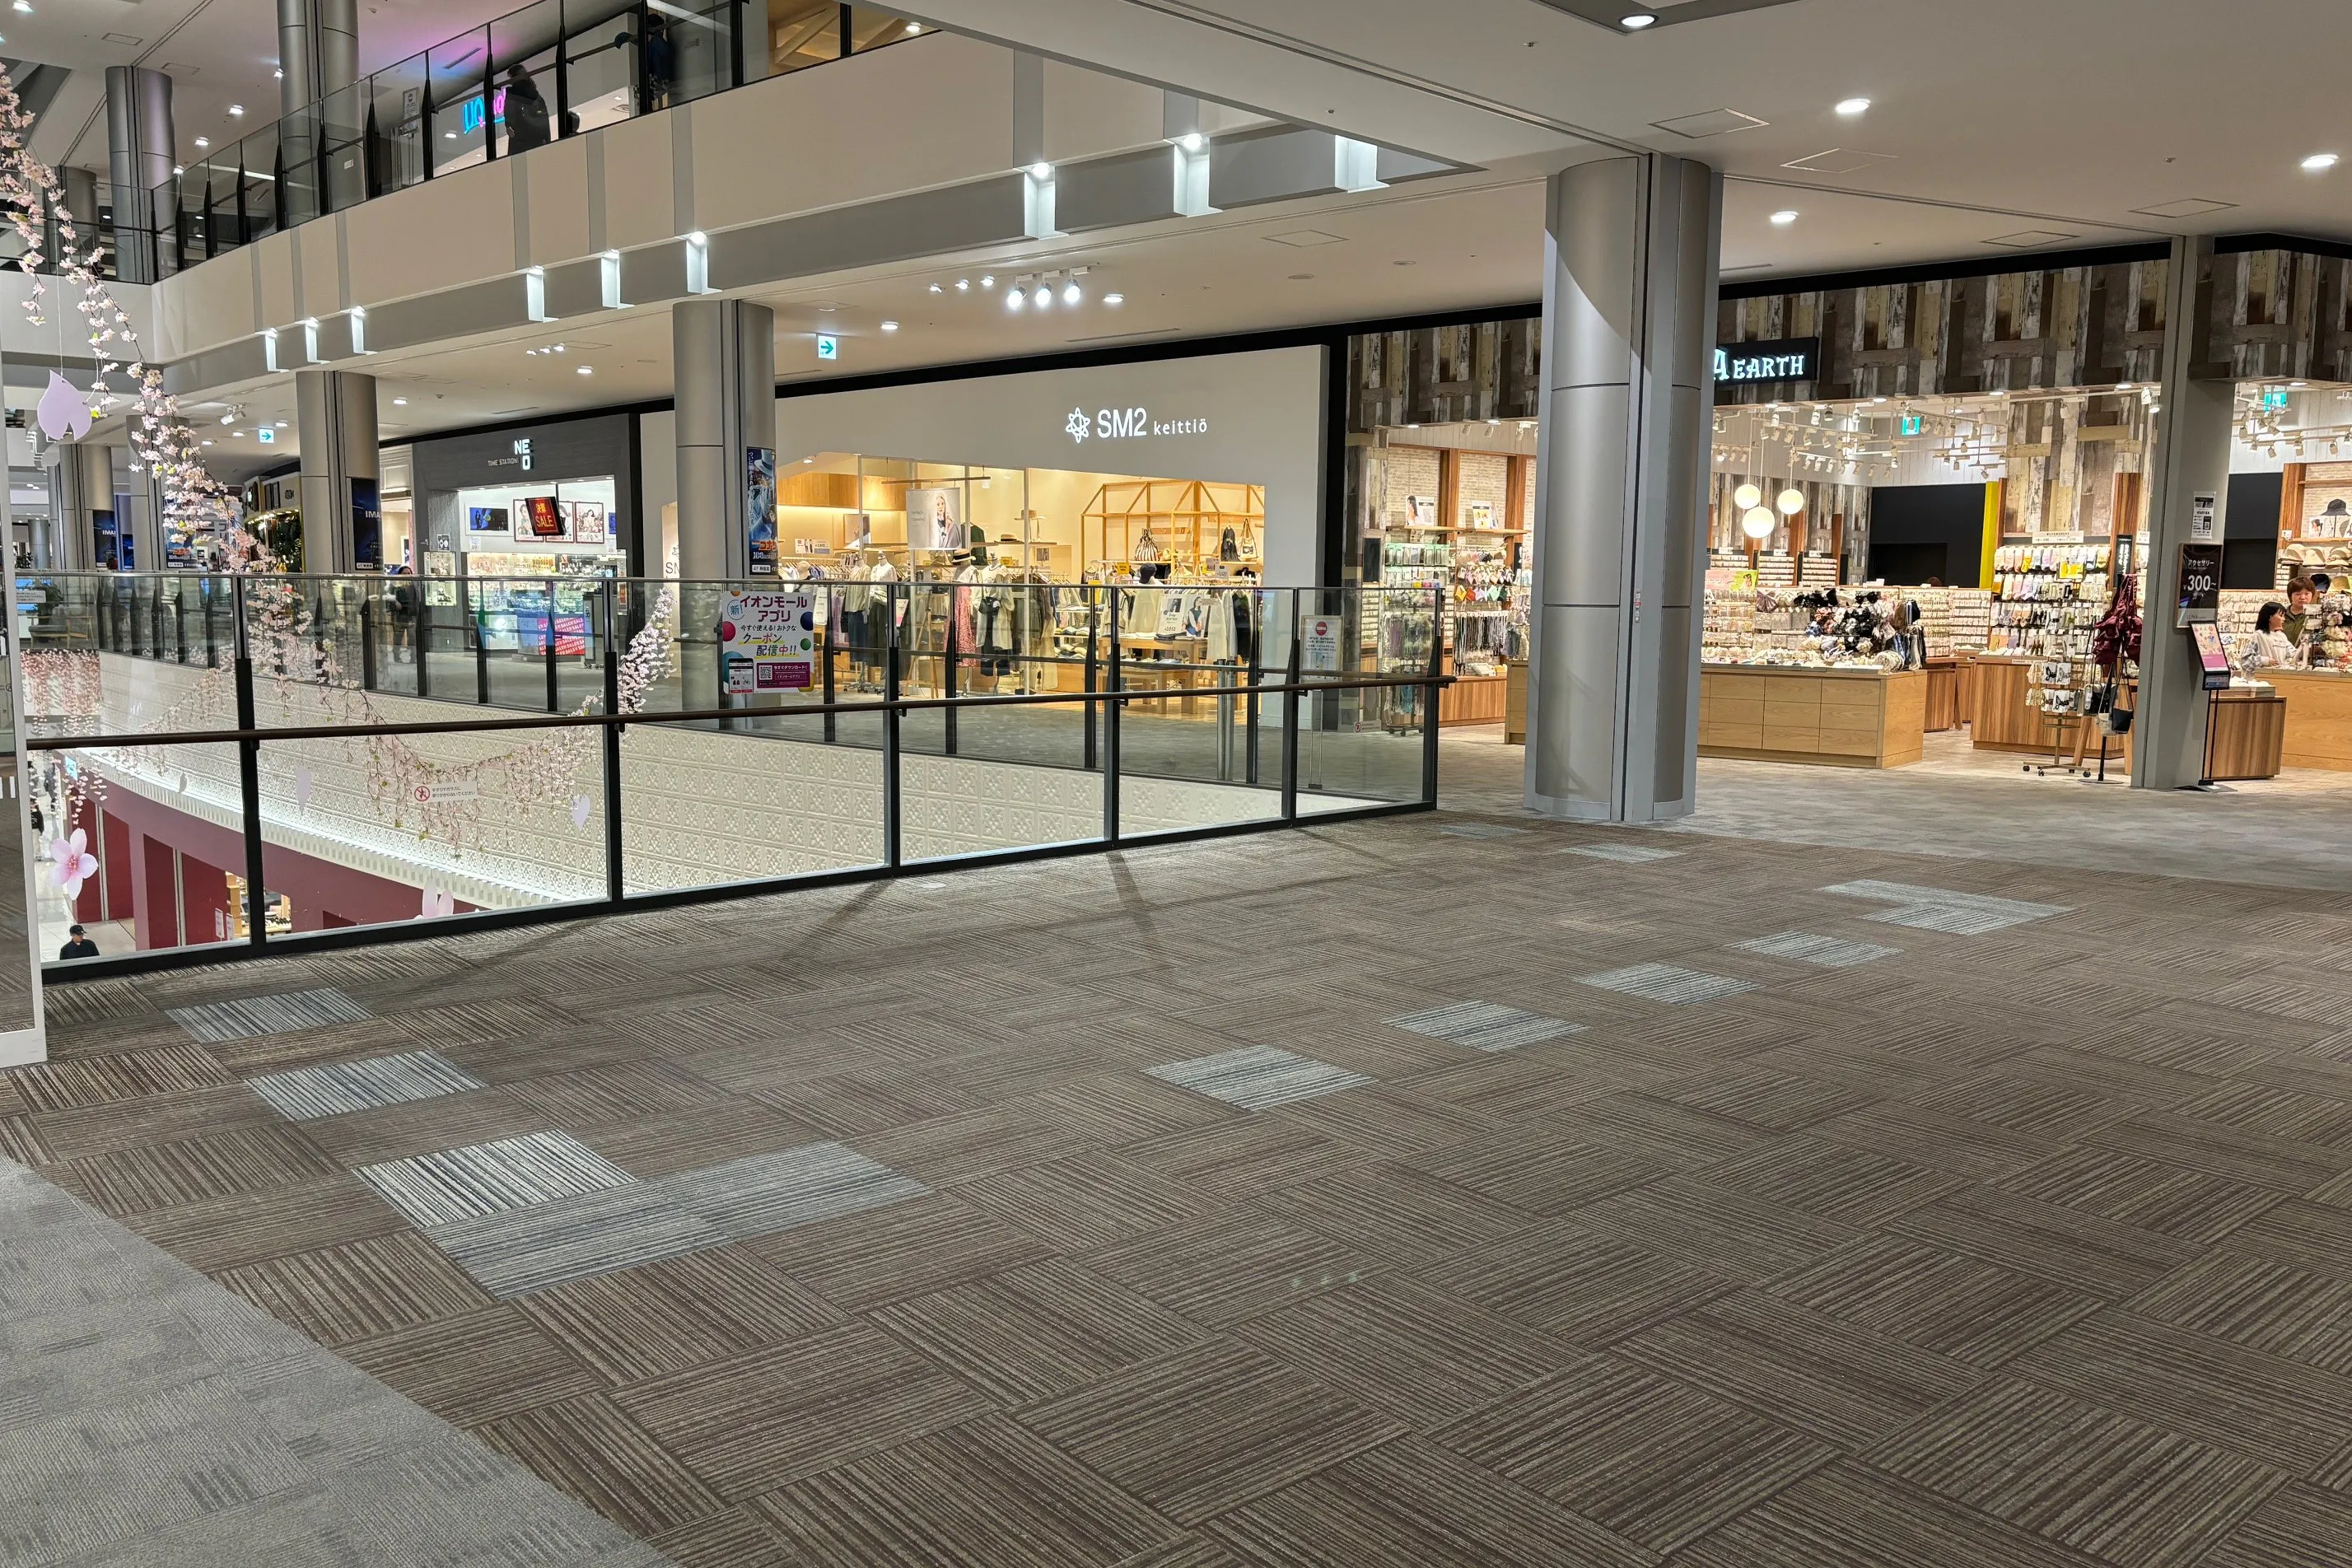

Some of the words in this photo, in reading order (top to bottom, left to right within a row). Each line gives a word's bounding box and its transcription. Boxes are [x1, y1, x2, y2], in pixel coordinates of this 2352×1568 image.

[1733, 355, 1804, 379] EARTH
[1097, 408, 1147, 438] SM2
[1154, 418, 1208, 436] keittiö
[535, 514, 554, 528] SALE
[740, 595, 807, 609] イオンモール
[758, 610, 791, 623] アプリ
[743, 632, 782, 643] クーポン
